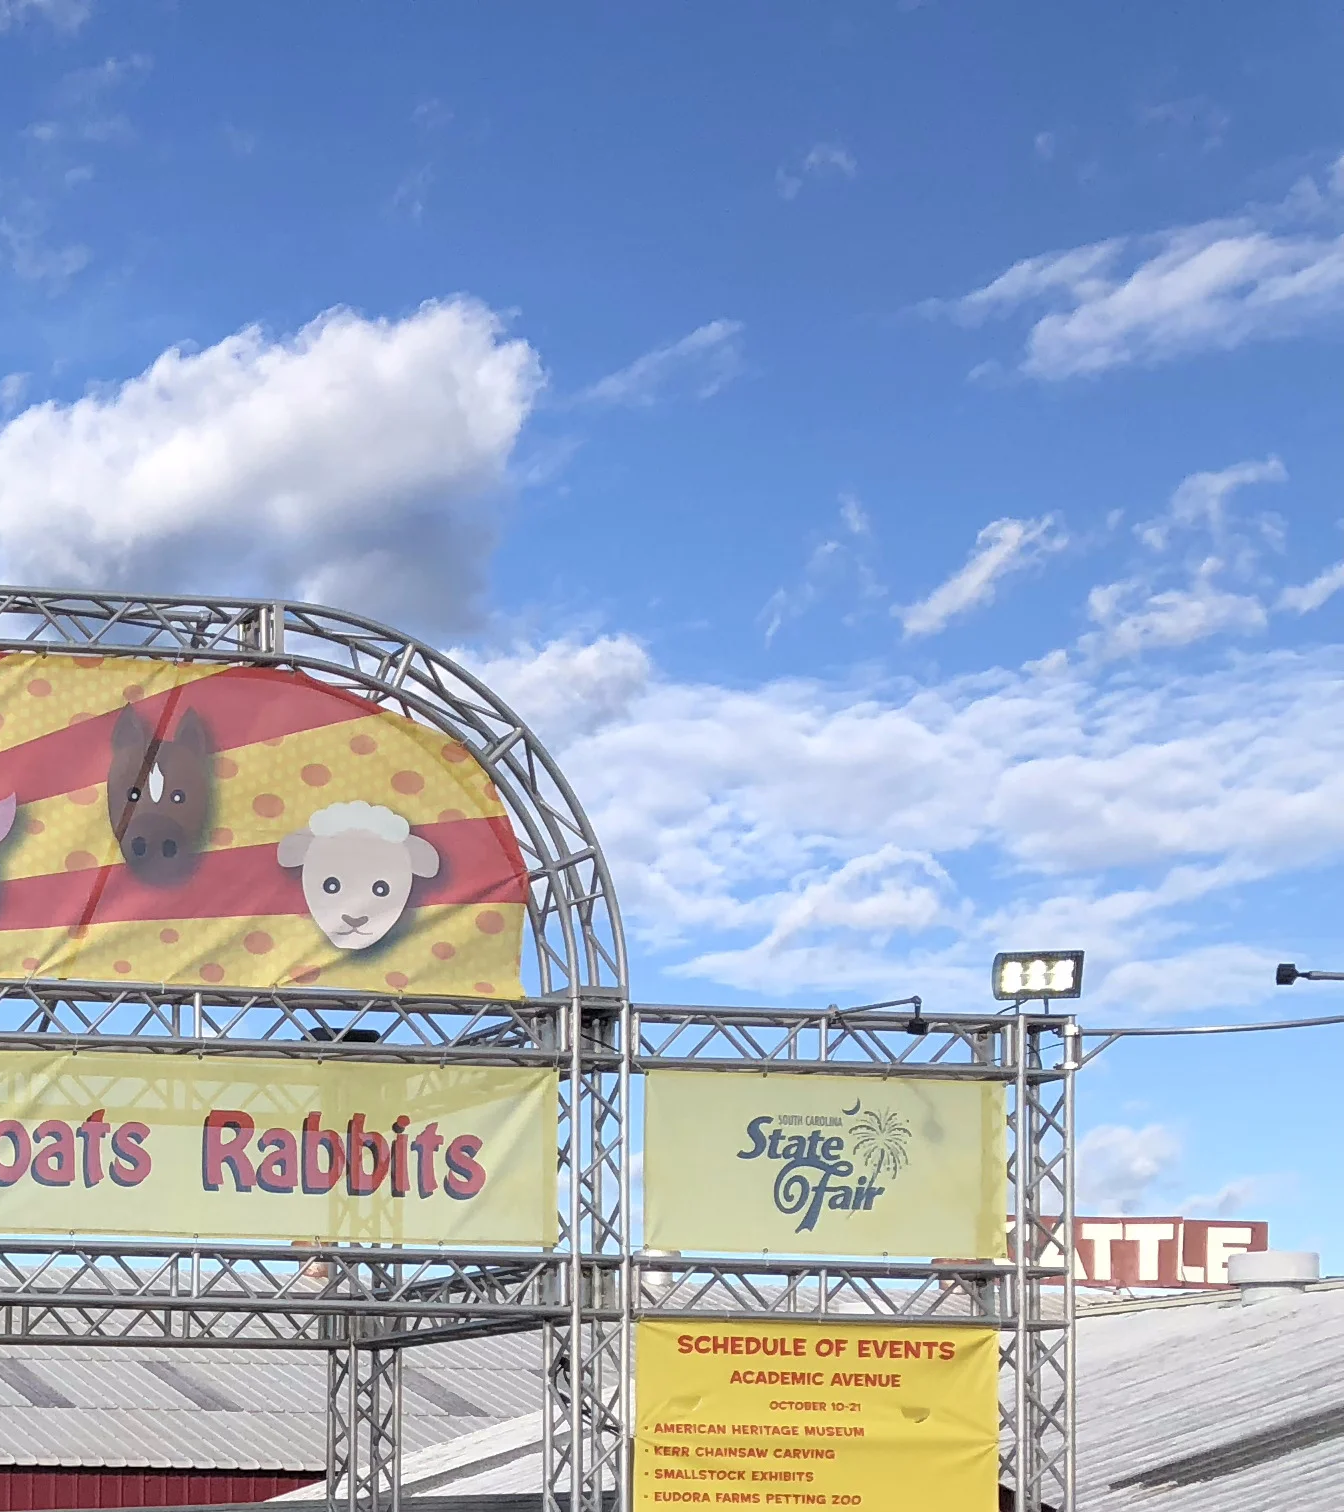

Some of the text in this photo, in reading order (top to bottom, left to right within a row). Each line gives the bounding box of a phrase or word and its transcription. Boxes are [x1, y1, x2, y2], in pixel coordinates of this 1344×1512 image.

[778, 1113, 843, 1128] SOUTH CAROLINA
[736, 1115, 844, 1160] State
[201, 1108, 487, 1200] Rabbits
[774, 1159, 885, 1234] Fair
[677, 1334, 956, 1361] SCHEDULE OF EVENTS
[730, 1370, 900, 1388] ACADEMIC AVENUE
[770, 1400, 861, 1413] OCTOBER 10-21
[654, 1423, 865, 1438] AMERICAN HERITAGE MUSEUM
[654, 1446, 836, 1460] KERR CHAINSAW CARVING
[654, 1468, 814, 1482] SMALLSTOCK EXHIBITS
[654, 1491, 862, 1506] EUDORA FARMS PETTING ZOO
